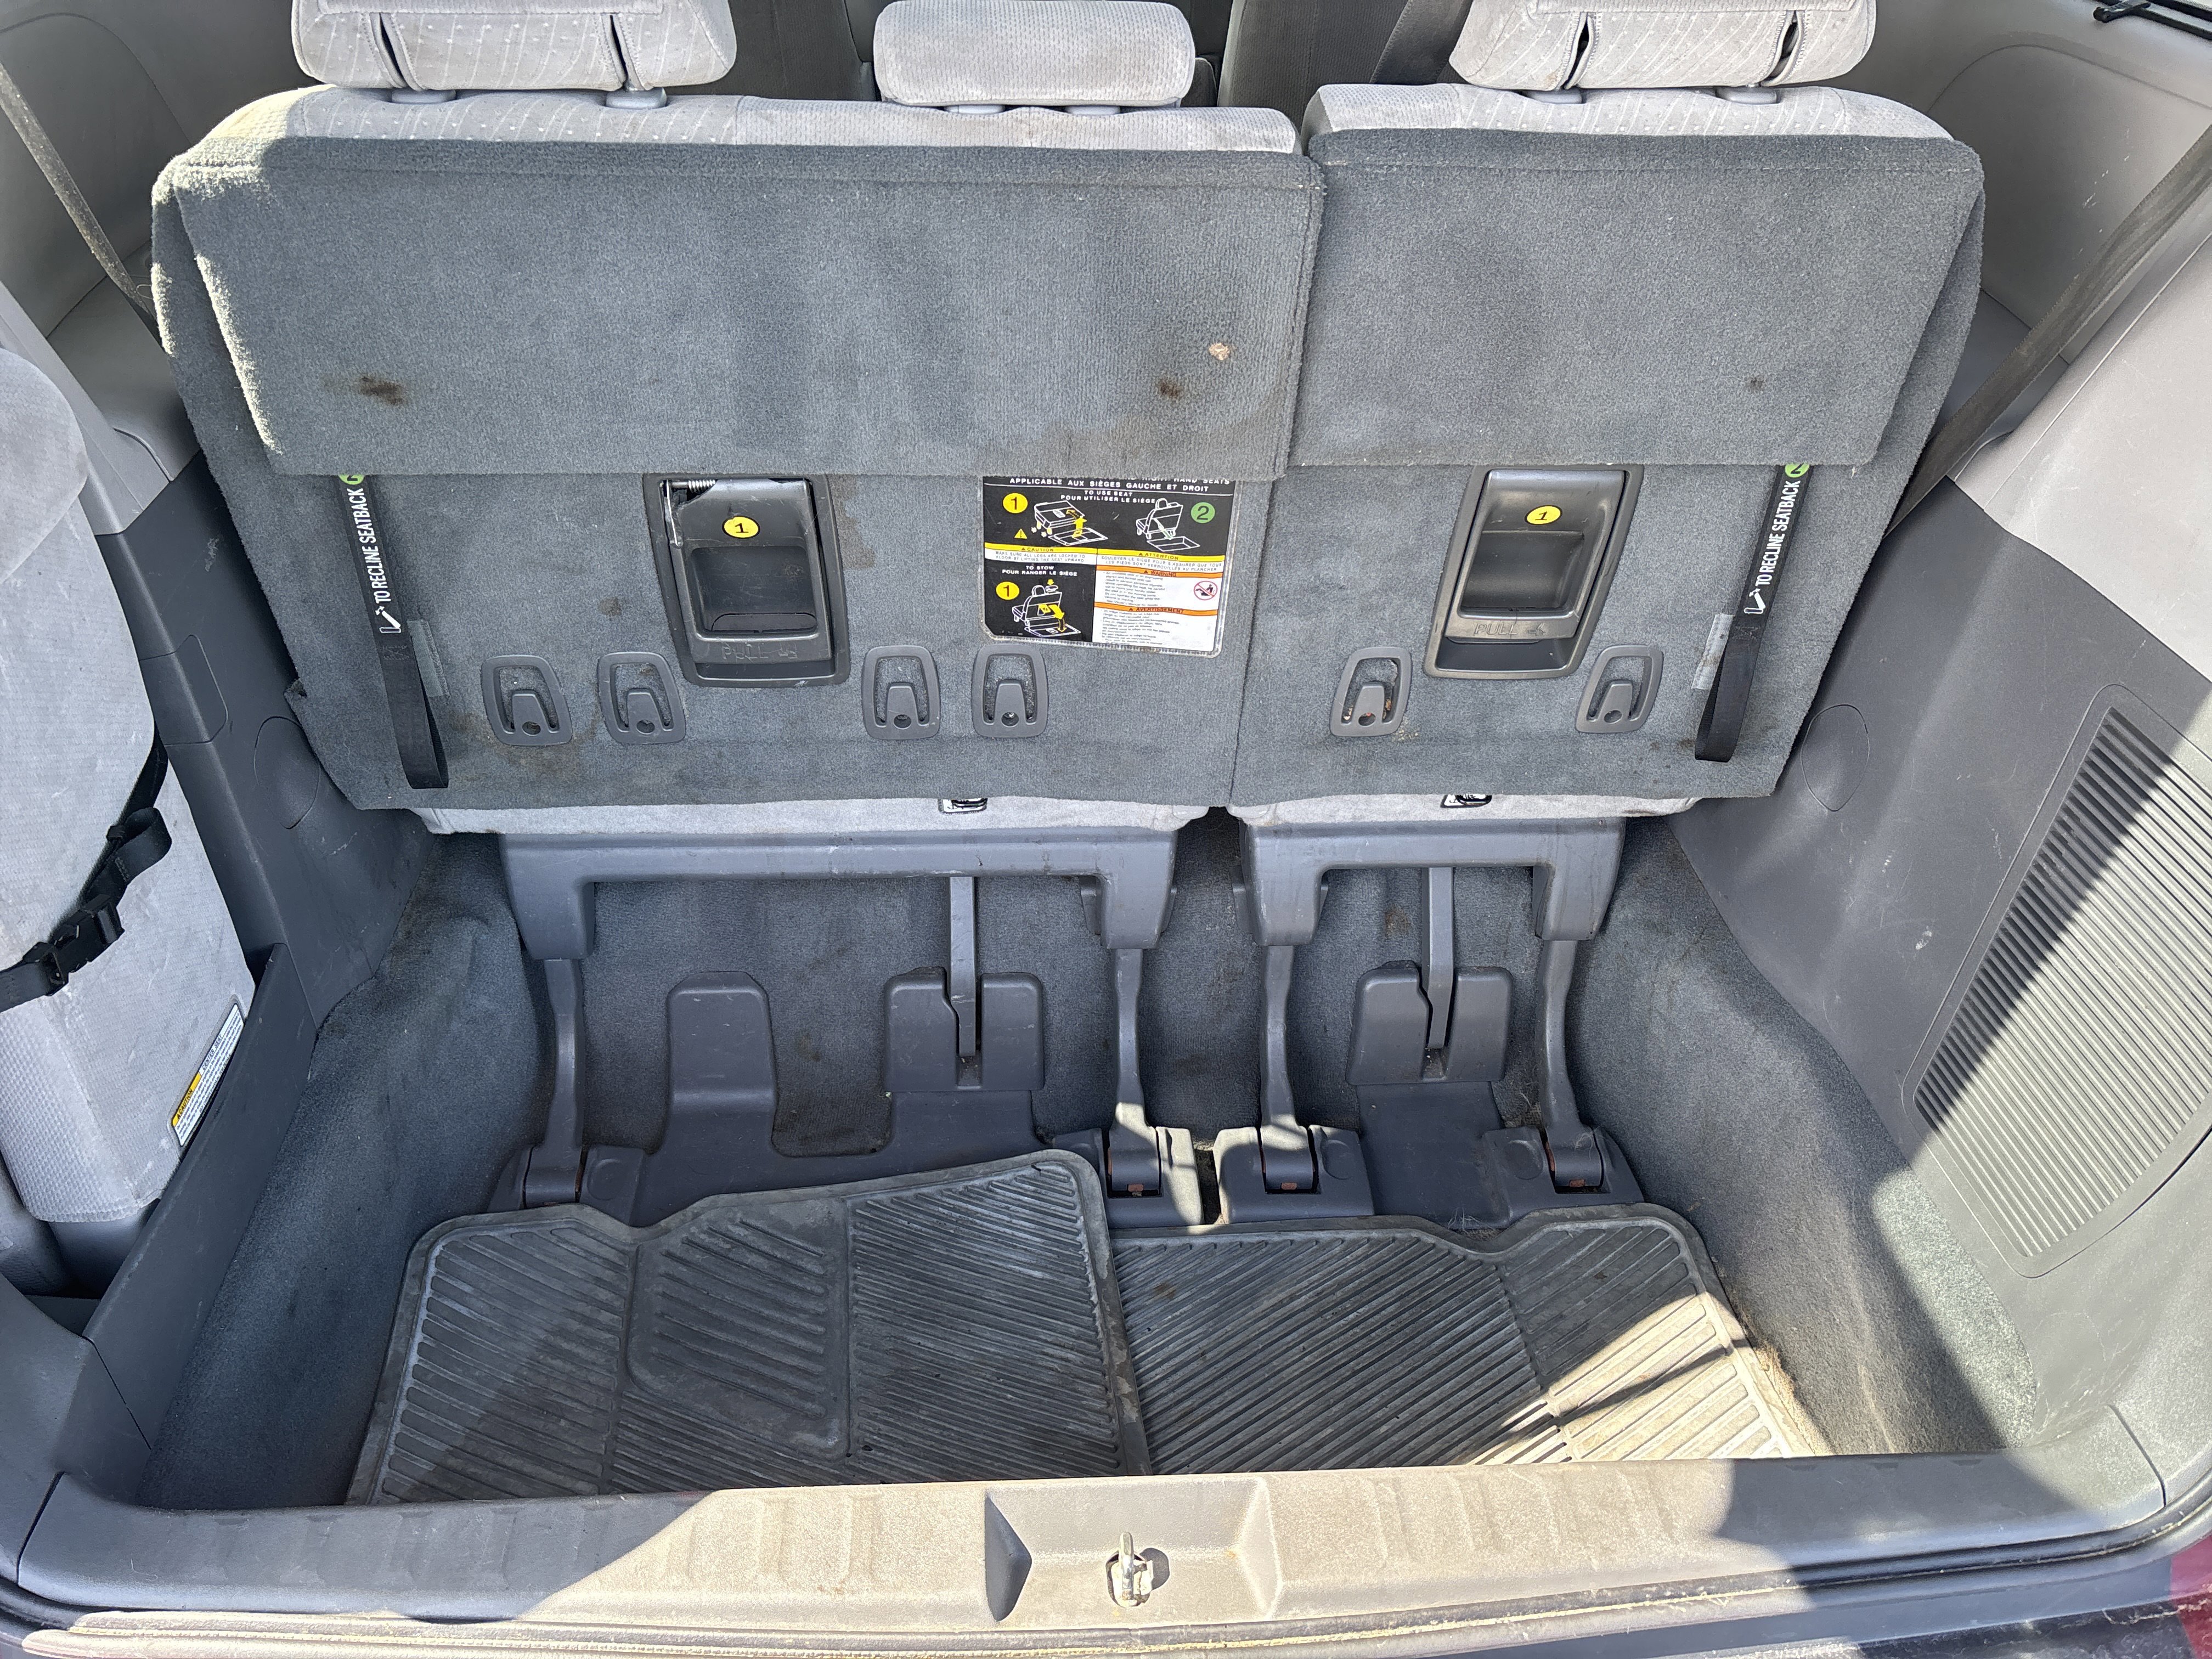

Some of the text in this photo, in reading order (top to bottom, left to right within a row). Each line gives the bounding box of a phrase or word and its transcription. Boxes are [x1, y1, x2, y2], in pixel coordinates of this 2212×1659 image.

[1011, 496, 1018, 510] 1
[347, 488, 376, 544] SEATBACK
[1197, 505, 1209, 521] 2
[1535, 511, 1548, 521] 1
[735, 523, 749, 534] 1
[1755, 480, 1801, 586] TO RECLINE SEATBACK
[362, 546, 388, 588] RECLINE
[374, 590, 391, 603] TO
[1003, 584, 1009, 597] 1
[1474, 624, 1518, 635] PULL
[179, 1088, 193, 1114] CAUTION
[202, 1048, 215, 1070] CENTER
[214, 1034, 222, 1049] SEAT
